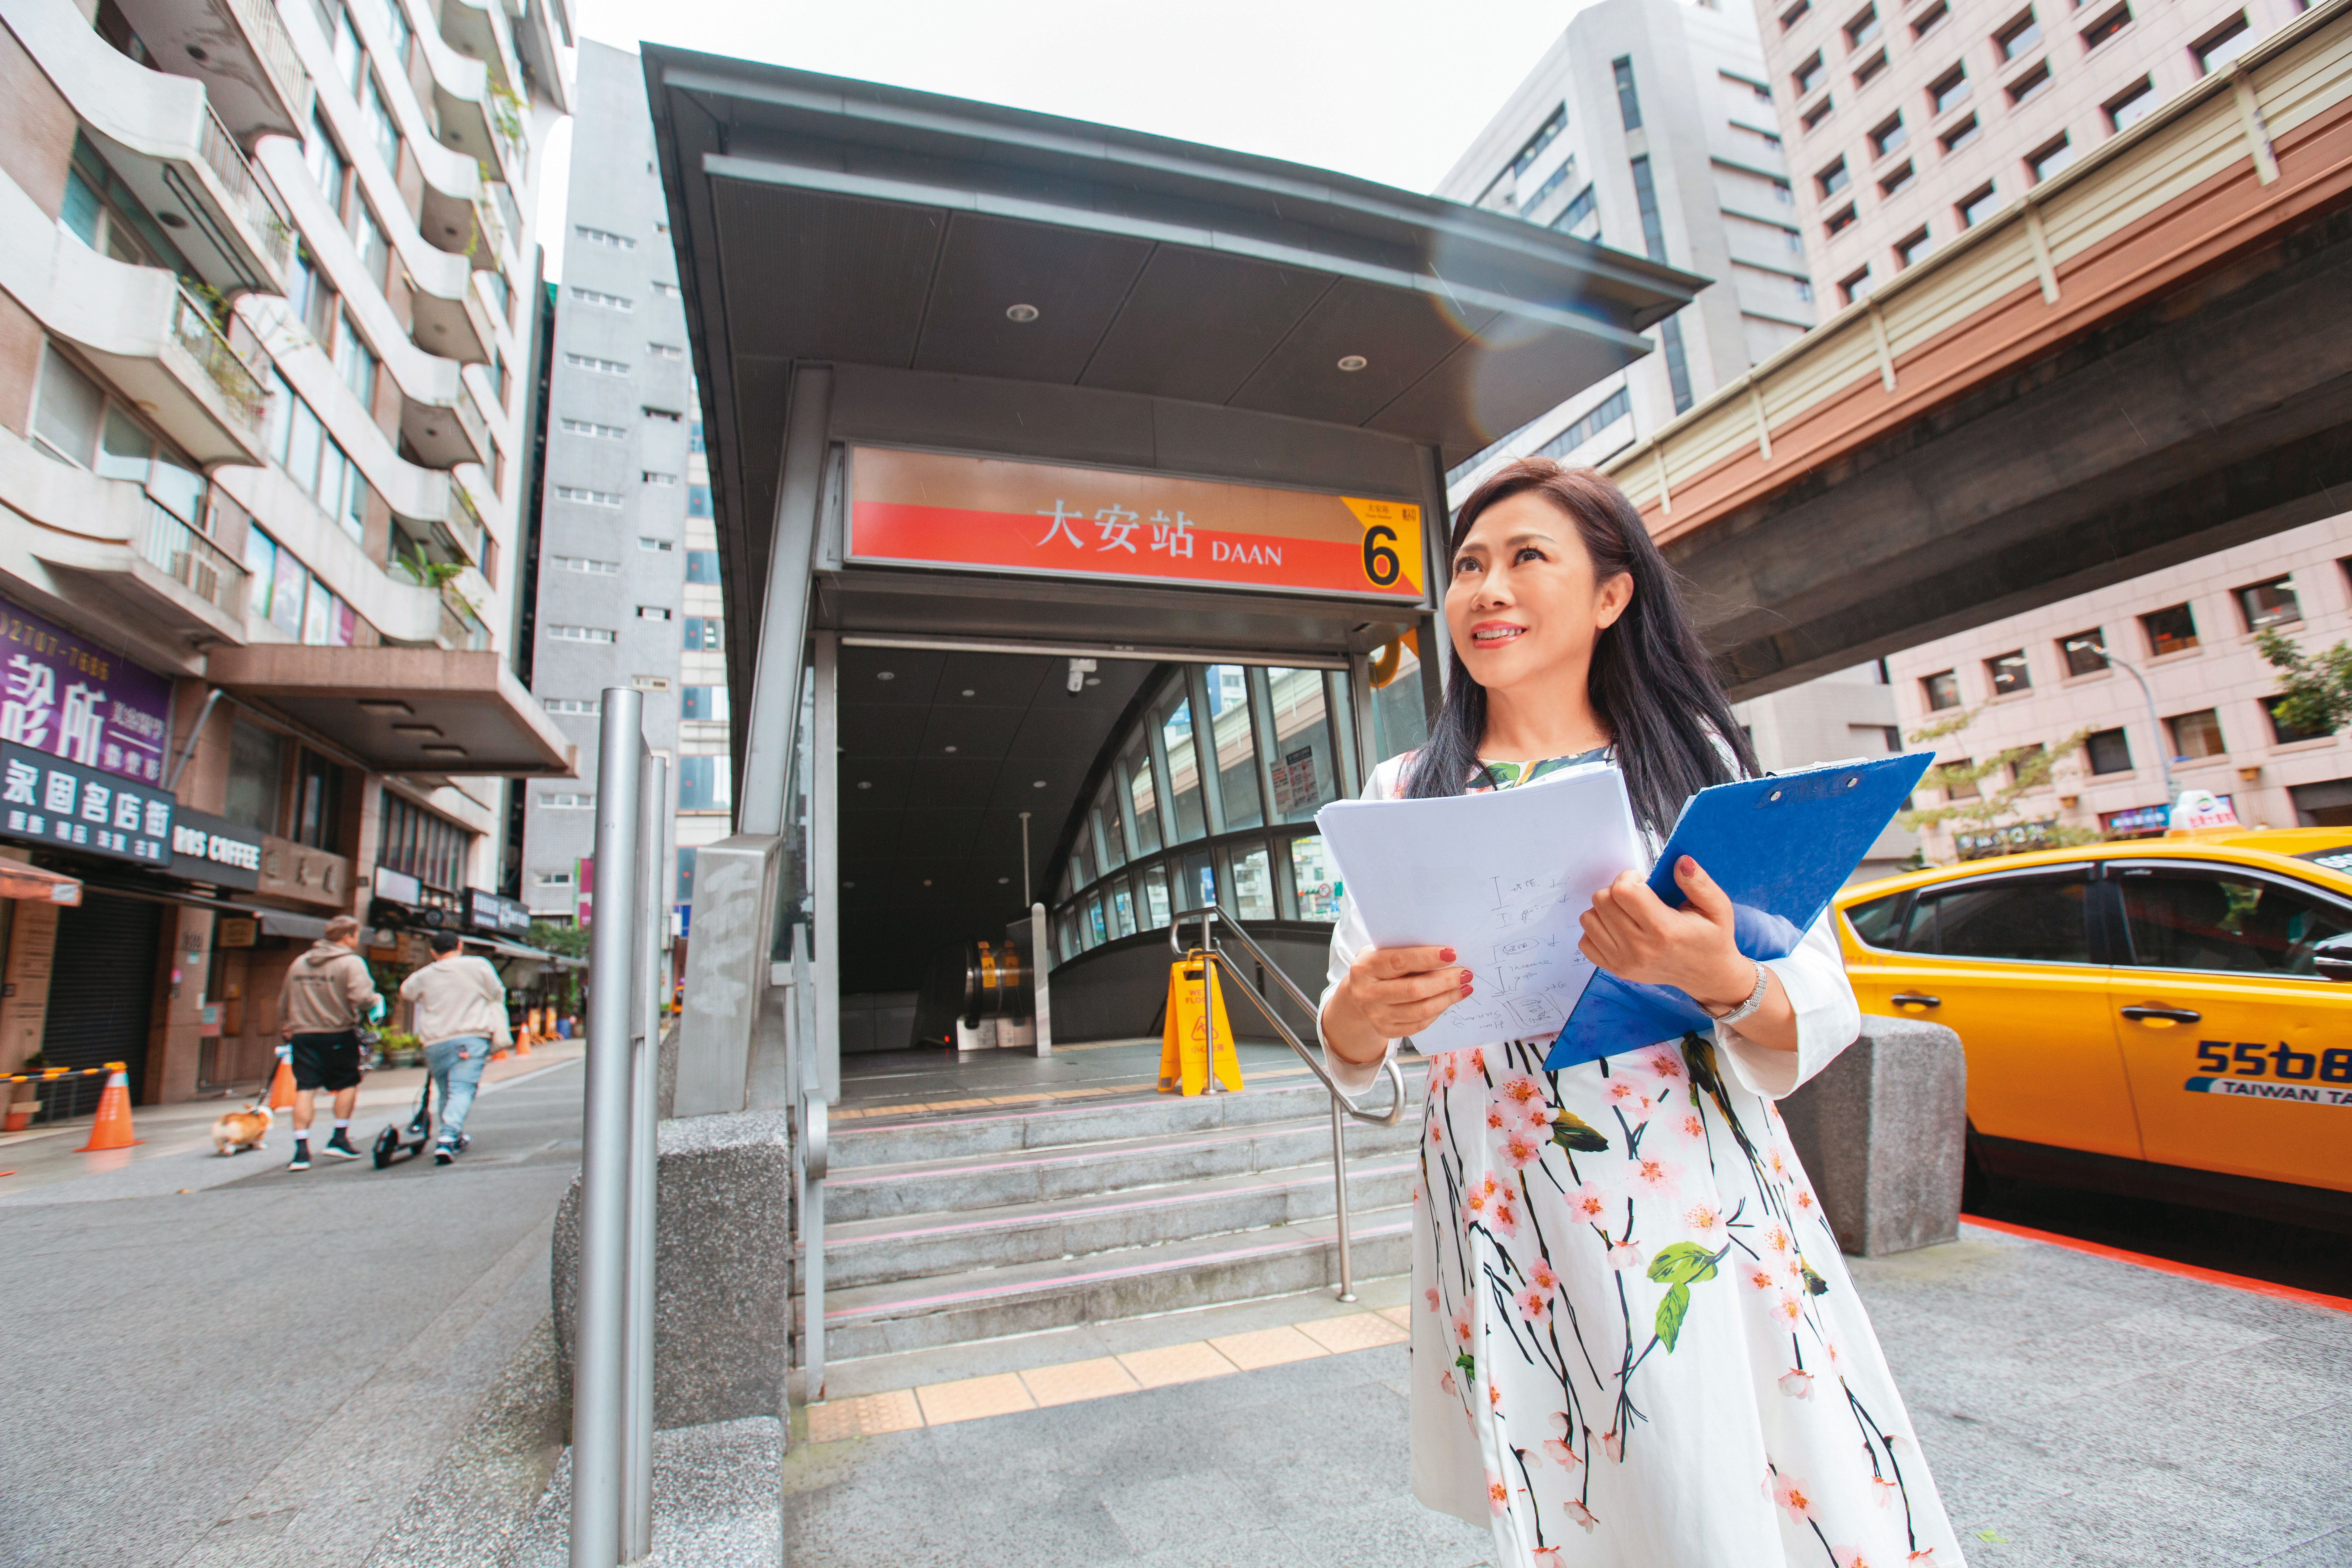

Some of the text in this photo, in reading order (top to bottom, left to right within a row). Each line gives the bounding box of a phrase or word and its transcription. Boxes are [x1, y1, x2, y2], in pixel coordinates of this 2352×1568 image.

[1036, 499, 1282, 566] 大安站 DAAN
[1364, 525, 1399, 586] 6
[0, 653, 107, 767] 診所
[207, 835, 262, 871] COFFEE
[2222, 1081, 2319, 1102] TAIWAN
